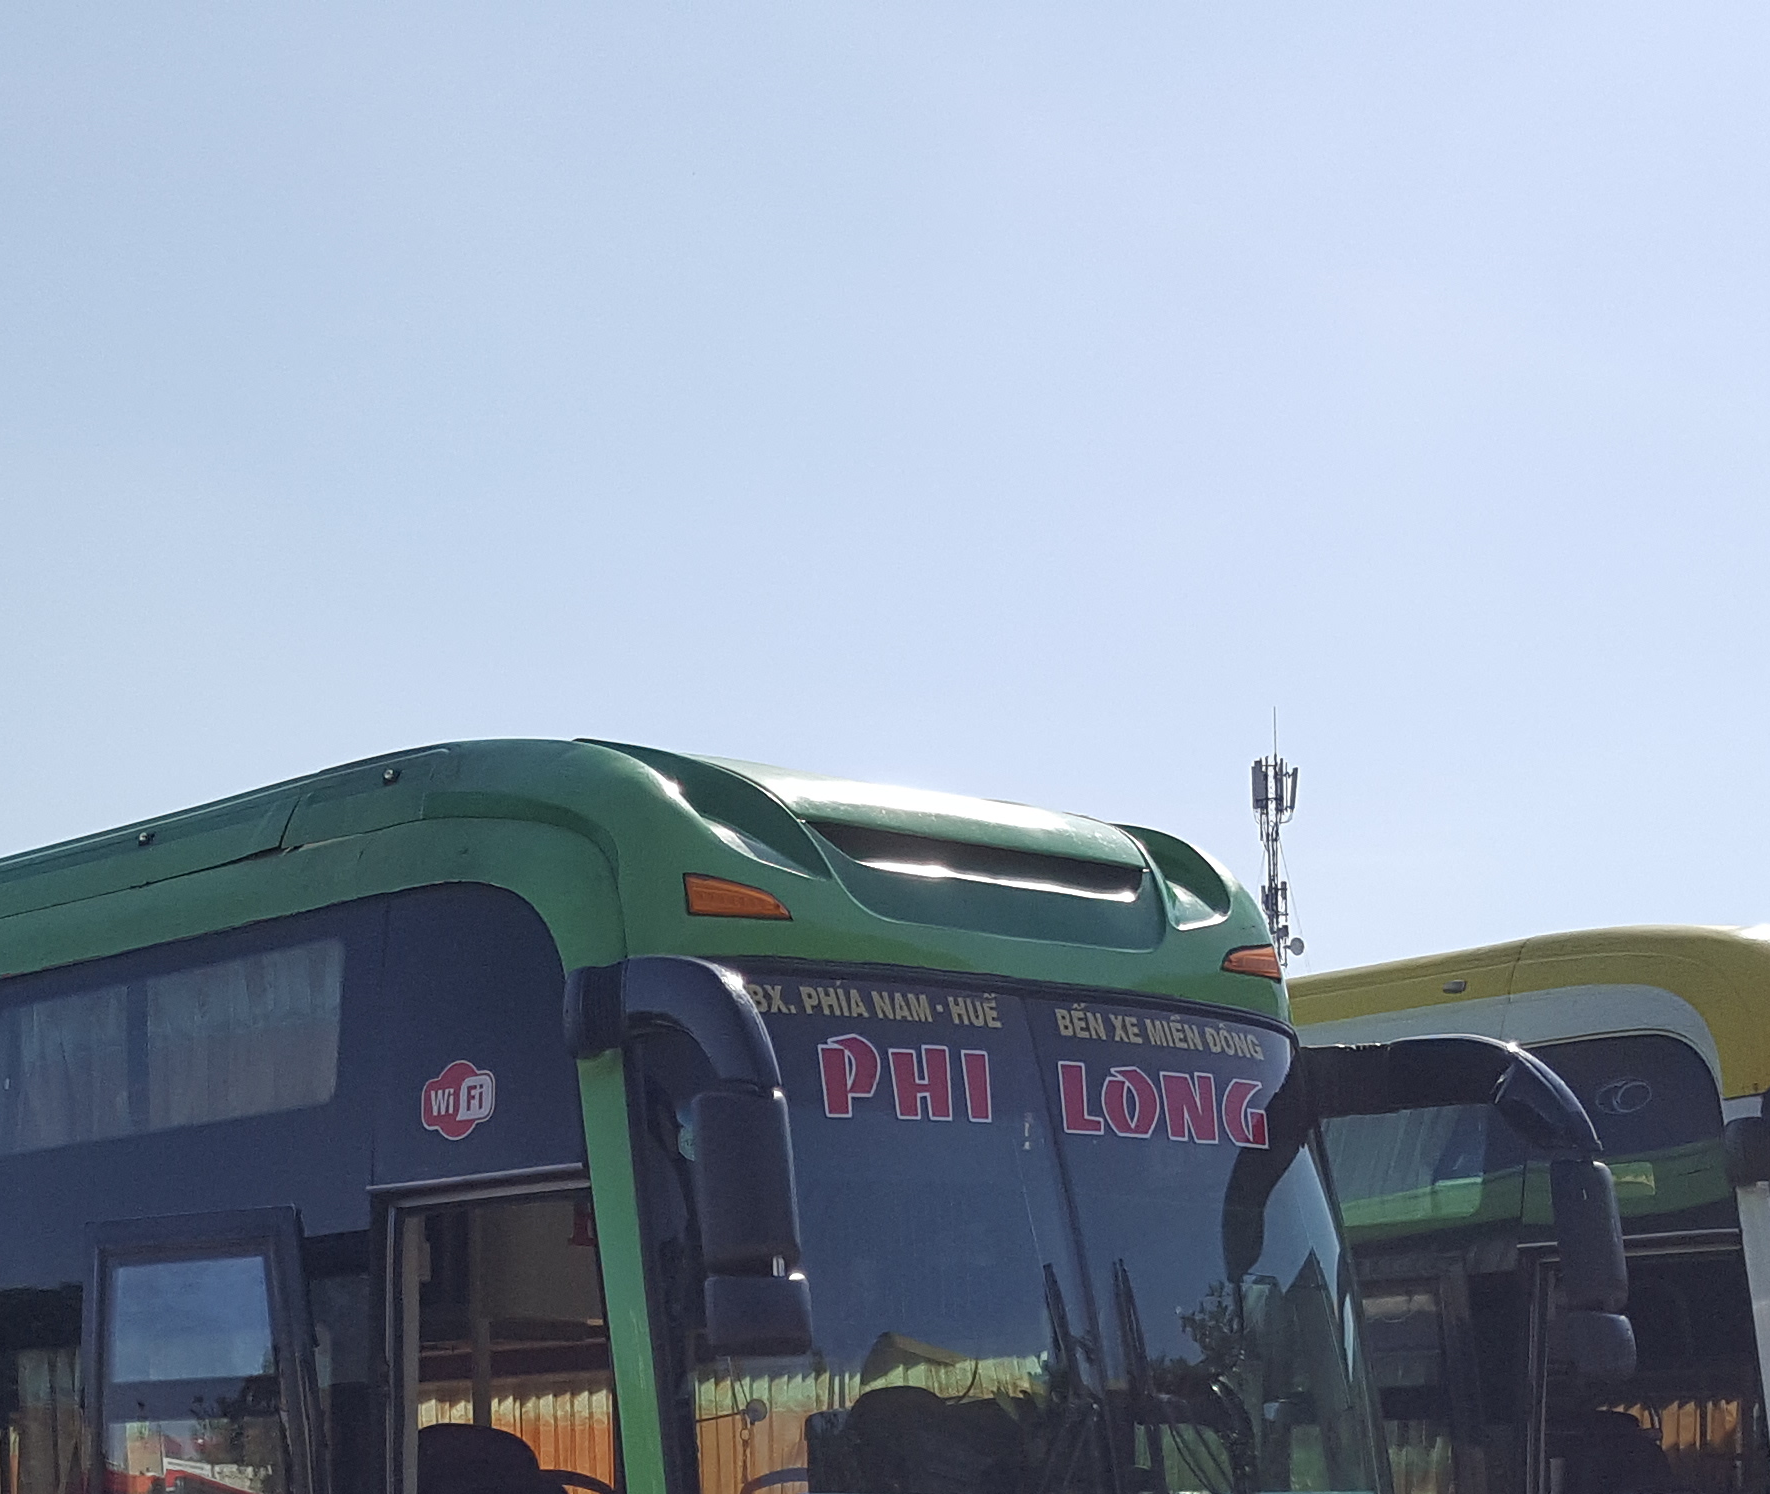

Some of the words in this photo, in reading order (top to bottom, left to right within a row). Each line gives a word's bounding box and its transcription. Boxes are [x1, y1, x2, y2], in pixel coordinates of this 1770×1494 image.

[747, 984, 796, 1014] BX.
[799, 981, 869, 1018] PHÍA
[871, 991, 932, 1022] NAM
[1055, 1003, 1106, 1040] BẾN
[1109, 1014, 1143, 1044] XE
[1205, 1023, 1265, 1060] ĐÔNG
[817, 1033, 992, 1122] PHI
[1058, 1060, 1269, 1149] LONG
